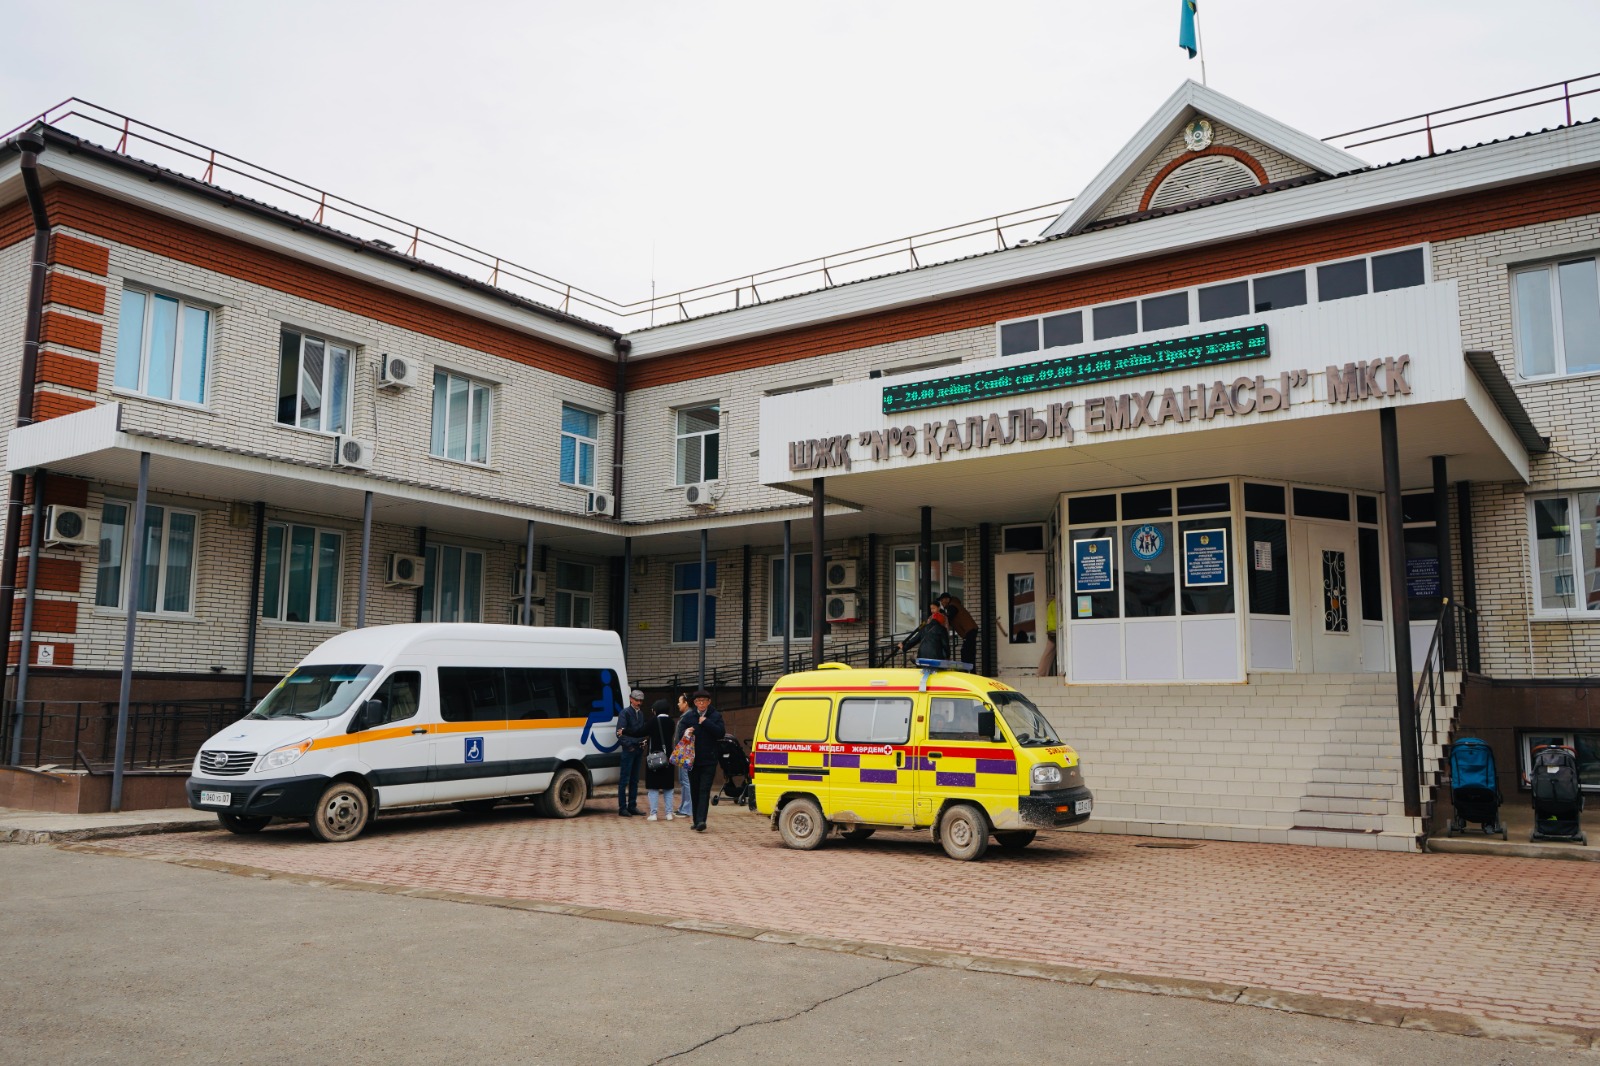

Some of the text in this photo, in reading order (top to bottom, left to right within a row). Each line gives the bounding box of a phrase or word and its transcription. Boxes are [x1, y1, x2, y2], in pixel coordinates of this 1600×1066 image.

[789, 434, 852, 471] ШЖҚ
[923, 401, 1074, 460] ҚАЛАЛЫҚ
[1325, 354, 1411, 404] МКК
[758, 743, 812, 752] МЕДИЦИНАЛЫҚ
